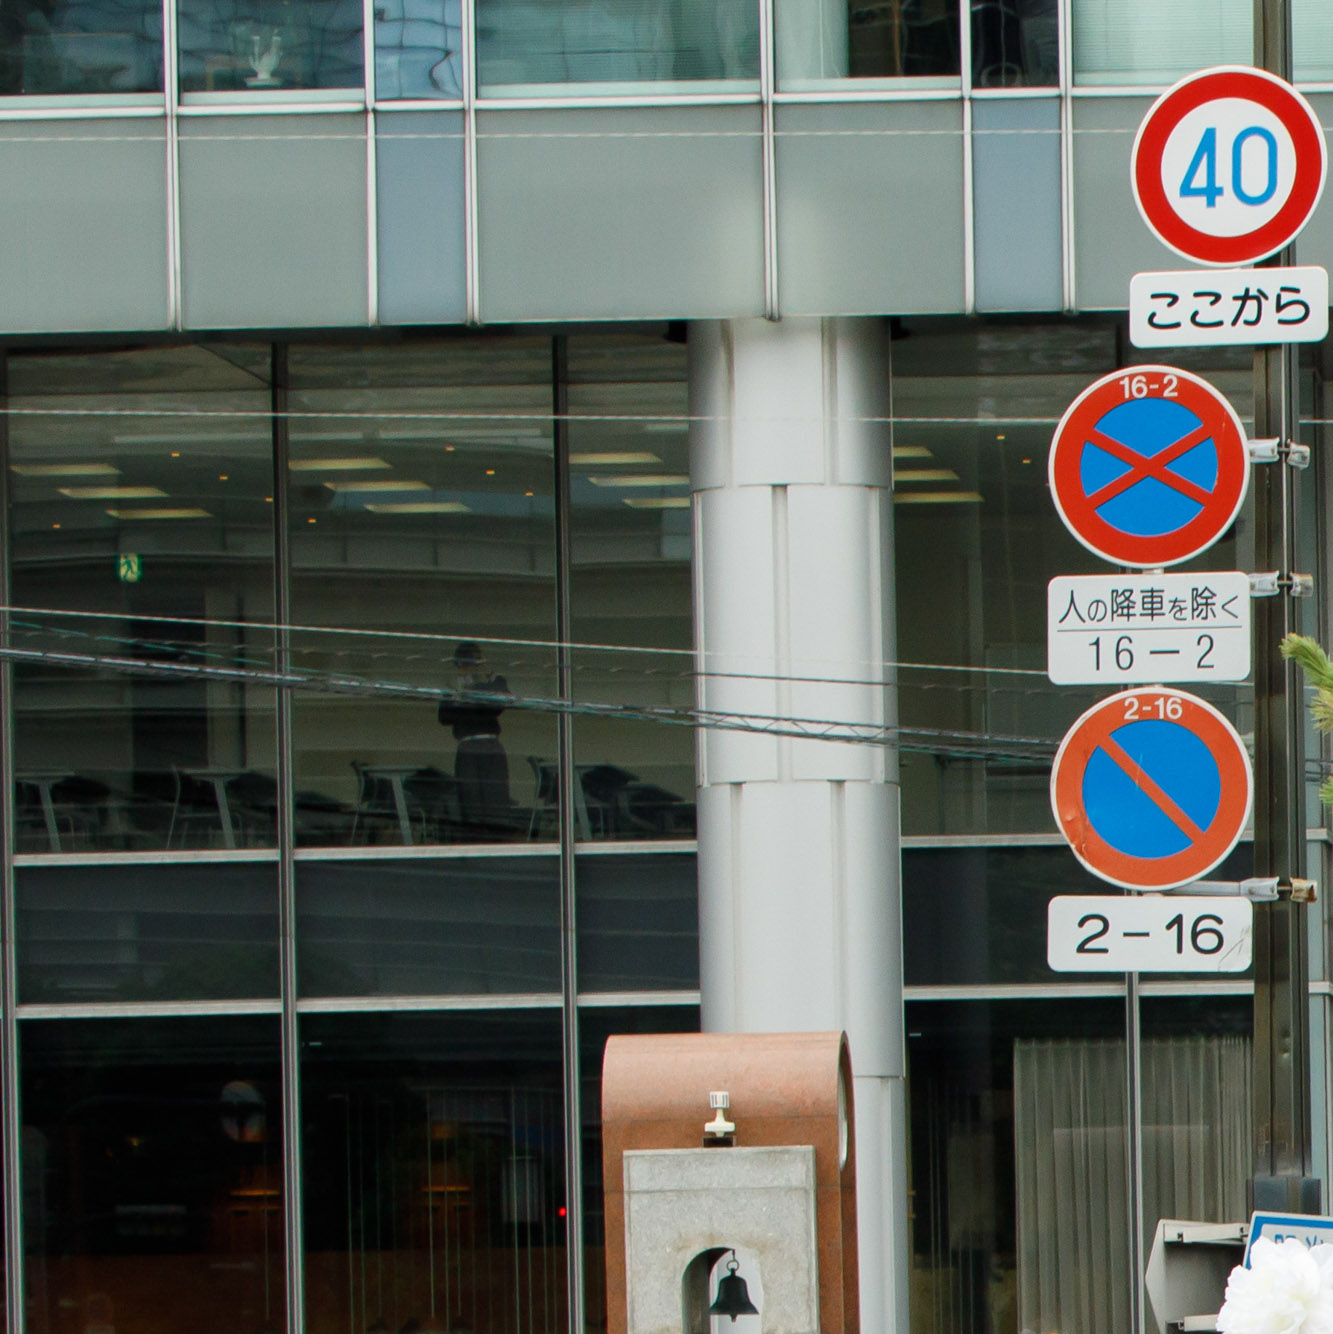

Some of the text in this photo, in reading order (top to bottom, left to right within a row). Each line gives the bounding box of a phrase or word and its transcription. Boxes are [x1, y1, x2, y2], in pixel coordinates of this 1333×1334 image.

[1179, 126, 1278, 208] 40
[1148, 287, 1311, 329] ここから
[1119, 375, 1178, 399] 16-2
[1058, 586, 1240, 624] 人の降車を除く
[1124, 697, 1183, 720] 2-16
[1075, 913, 1225, 955] 2-16
